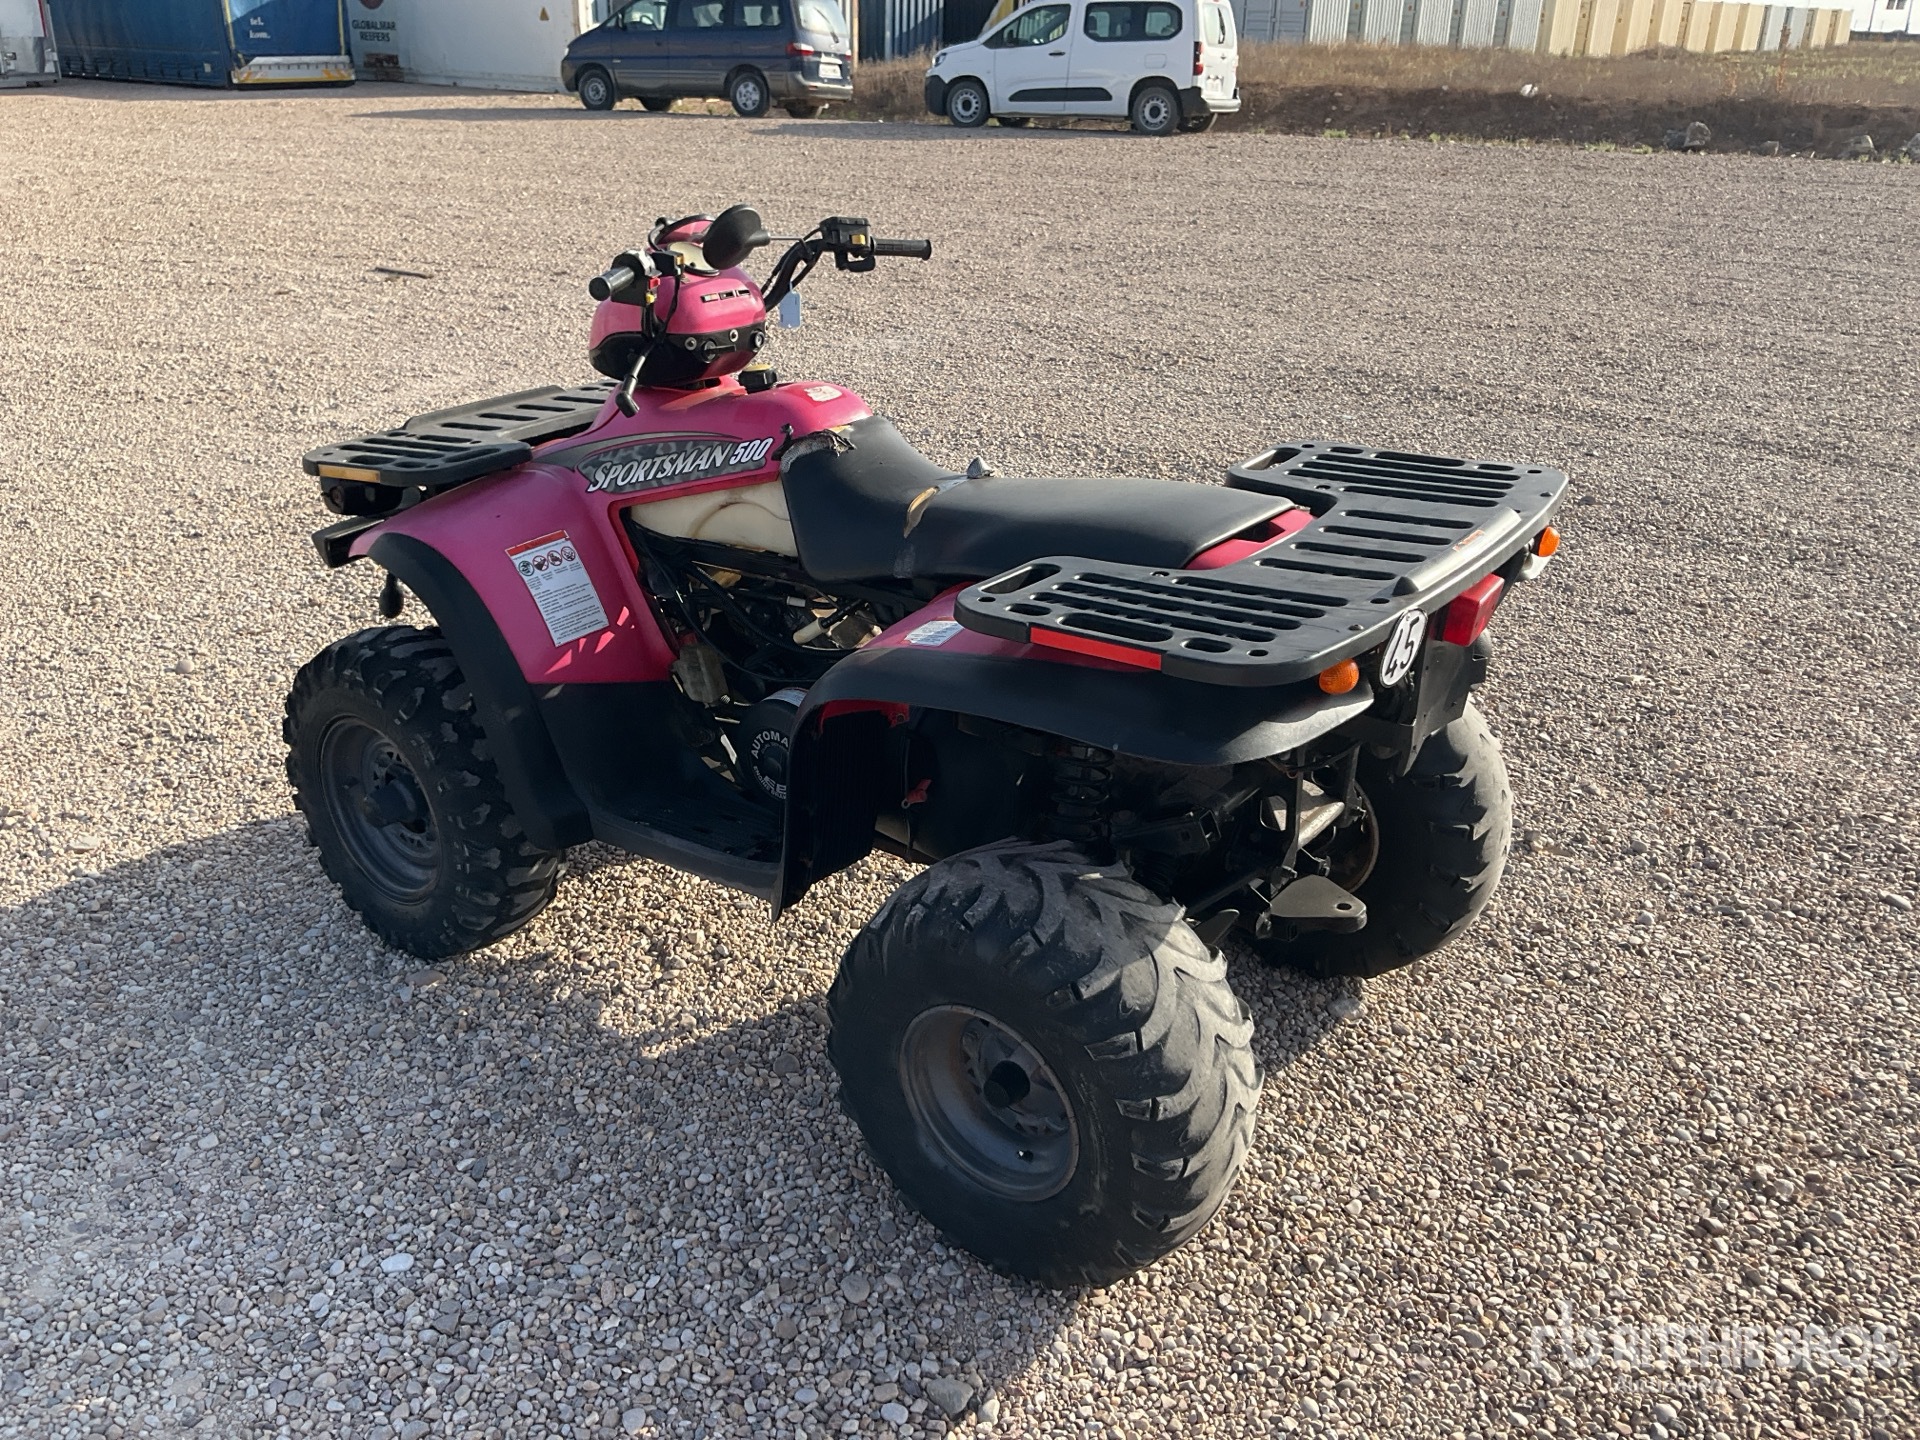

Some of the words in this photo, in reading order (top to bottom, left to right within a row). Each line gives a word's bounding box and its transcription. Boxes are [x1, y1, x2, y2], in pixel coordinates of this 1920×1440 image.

[587, 443, 731, 493] SPORTSMAN
[729, 437, 774, 466] 500
[1384, 615, 1421, 679] 45
